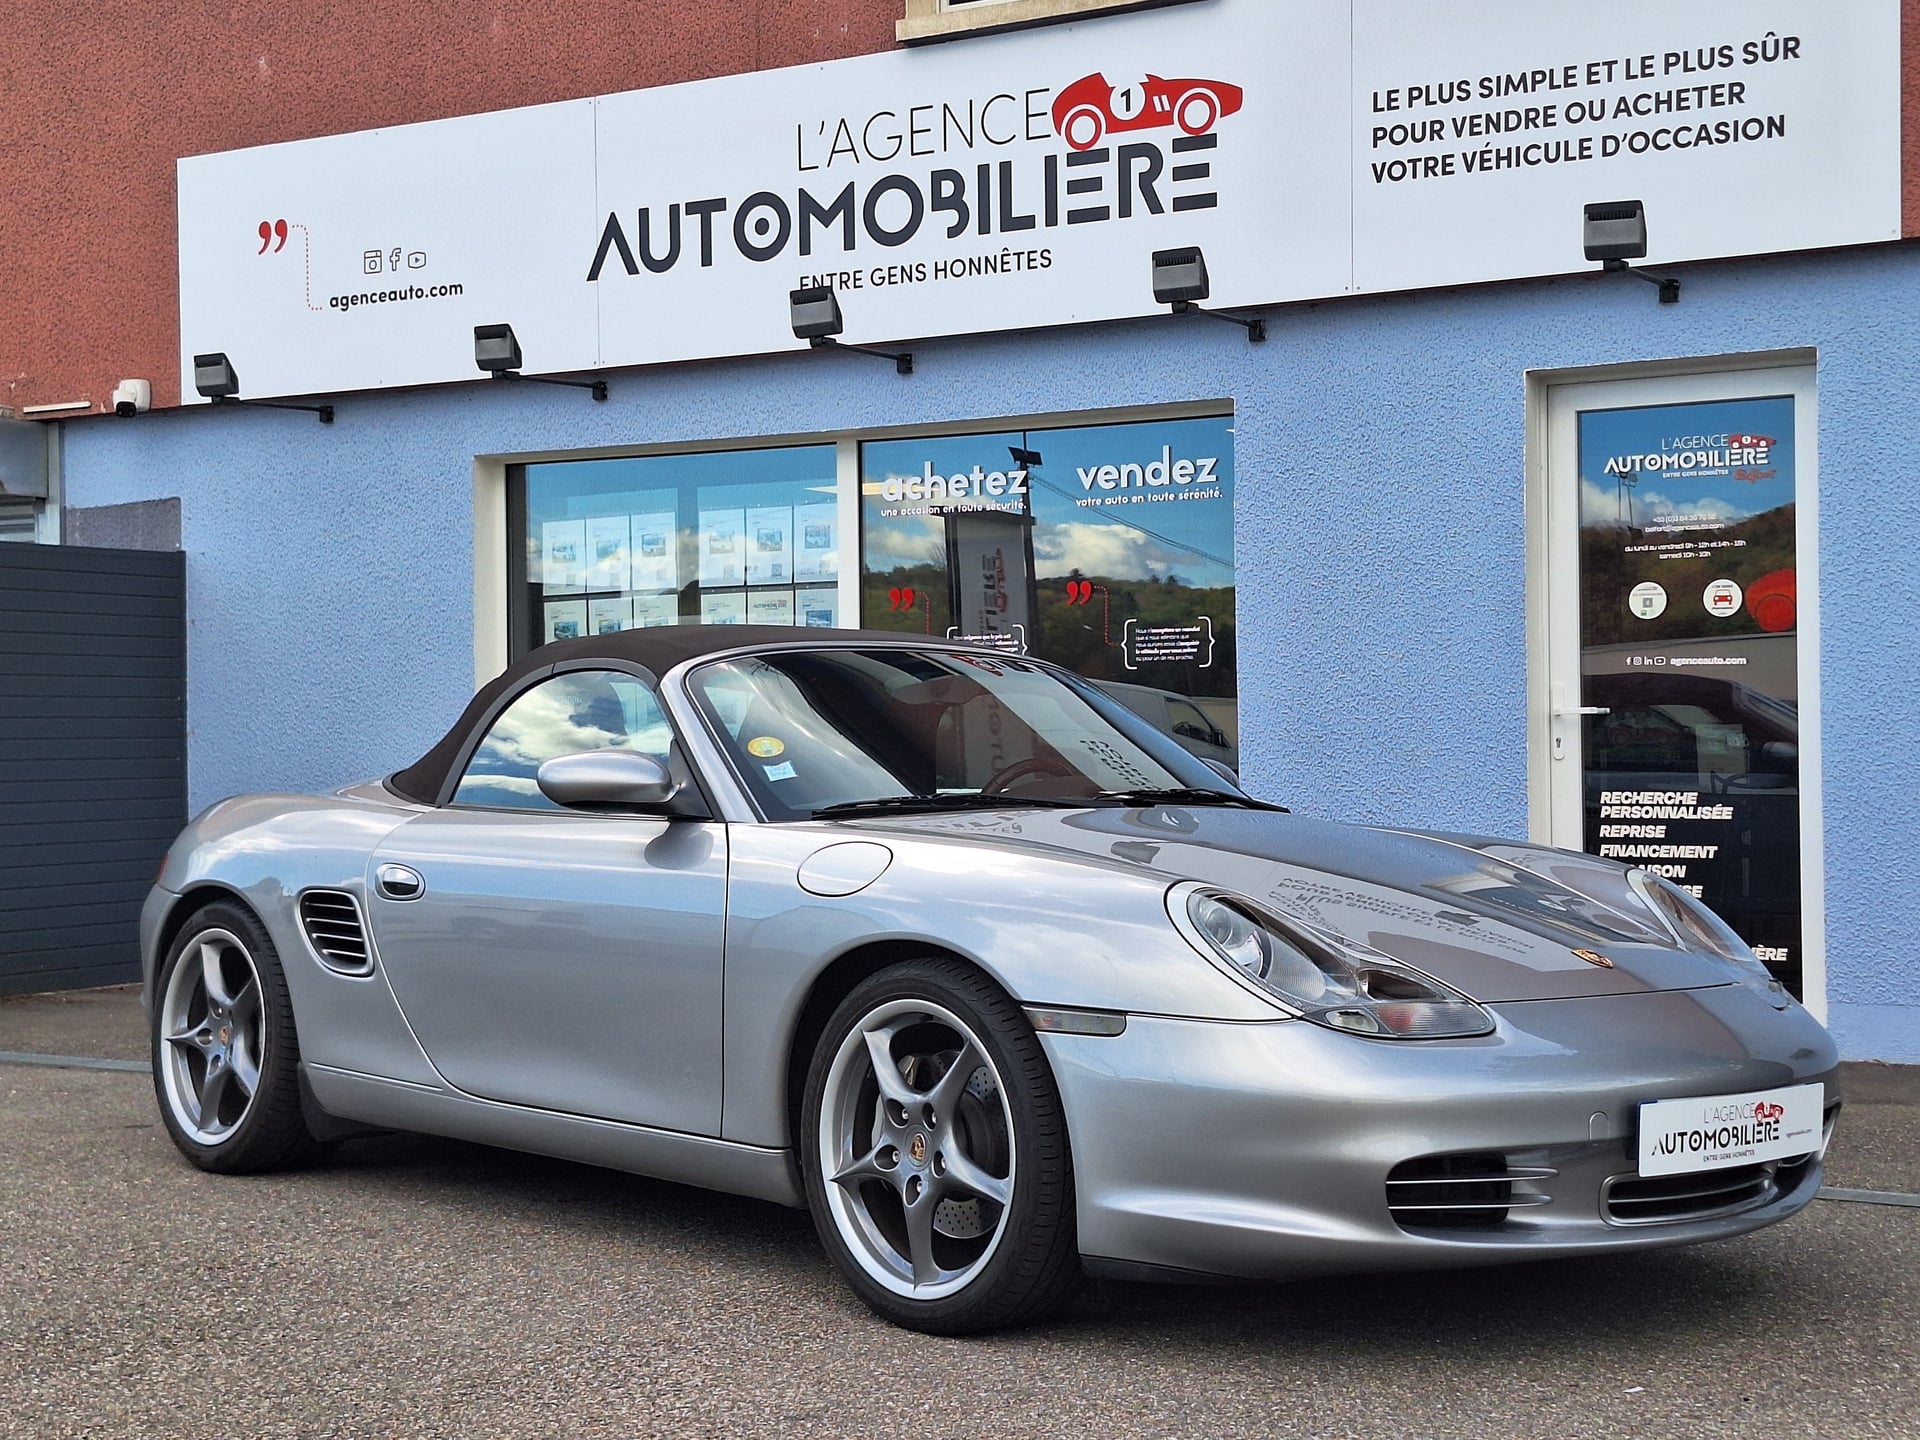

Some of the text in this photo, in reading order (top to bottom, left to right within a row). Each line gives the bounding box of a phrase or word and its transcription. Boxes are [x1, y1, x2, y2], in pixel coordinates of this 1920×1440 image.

[1372, 31, 1801, 113] LE PLUS SIMPLE ET LE PLUS SÛR
[1372, 81, 1745, 149] POUR VENDRE OU ACHETER
[1371, 153, 1455, 183] VOTRE
[1462, 138, 1593, 174] VÉHICULE
[870, 262, 927, 287] GENS
[934, 247, 1052, 281] HONNÊTES
[328, 282, 464, 312] agenceauto.com
[881, 460, 1029, 503] achetez
[1076, 445, 1218, 492] vendez
[942, 504, 955, 514] en
[957, 502, 983, 513] toute
[1075, 496, 1102, 507] votre
[1105, 494, 1129, 506] auto
[1131, 494, 1144, 504] en
[1148, 492, 1175, 503] toute
[1600, 791, 1698, 805] RECHERCHE
[1600, 804, 1733, 820] PERSONNALISÉE
[1600, 825, 1666, 838] REPRISE
[1600, 845, 1718, 859] FINANCEMENT
